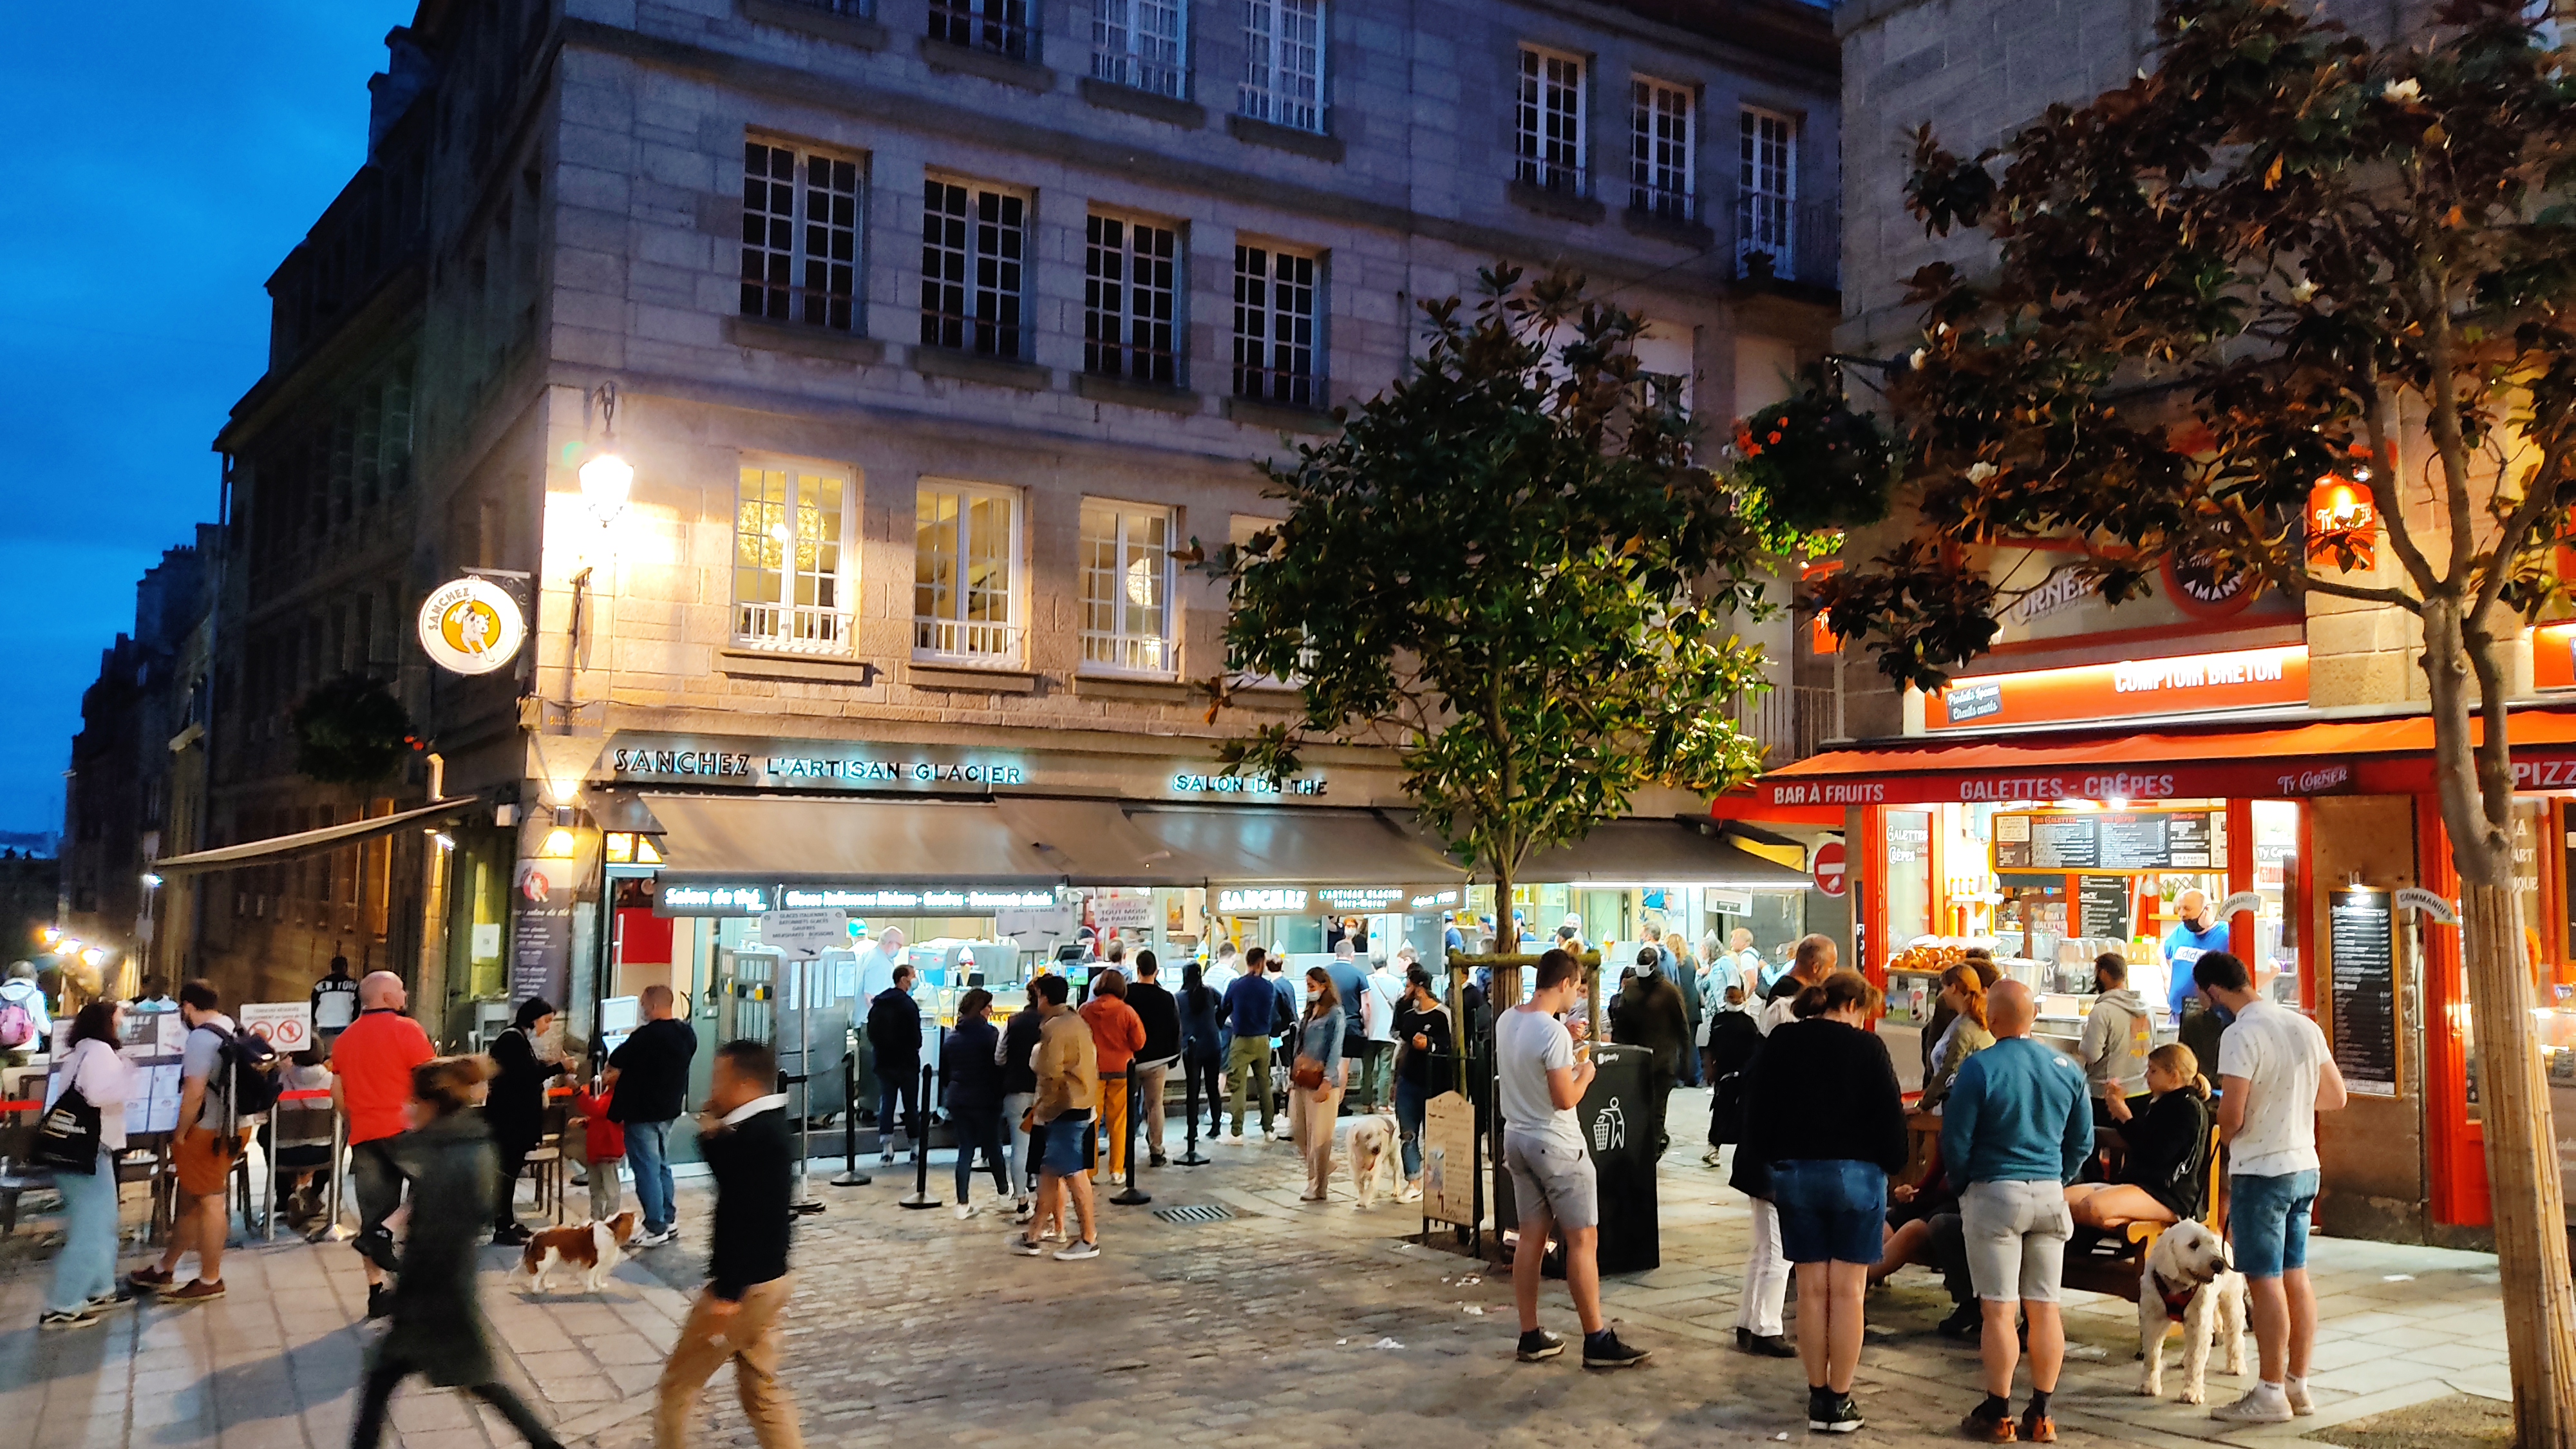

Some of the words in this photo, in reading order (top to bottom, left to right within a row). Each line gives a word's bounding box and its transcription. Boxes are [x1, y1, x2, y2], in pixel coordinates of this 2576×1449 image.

[428, 587, 469, 630] SANCHEZ
[2114, 660, 2204, 693] COMPTOIR
[2207, 658, 2282, 686] BRETON
[1953, 704, 1977, 721] Circuits
[1977, 699, 1998, 715] courts
[614, 748, 750, 777] SANCHEZ
[764, 757, 900, 781] L'ARTISAN
[913, 762, 1020, 785] GLACIER
[1173, 773, 1244, 793] SALON
[1774, 786, 1805, 804] BAR
[1808, 782, 1821, 803] À
[1825, 784, 1884, 802] FRUITS
[1960, 777, 2063, 800] GALETTES
[2084, 773, 2174, 799] CRÊPES
[1886, 824, 1928, 842] GALETTES
[1888, 845, 1916, 865] CRÊPES
[2257, 846, 2269, 860] Ty
[1218, 889, 1308, 911] SANCHEZ
[1365, 889, 1404, 900] GLACIER
[2400, 892, 2452, 921] COMMANDES
